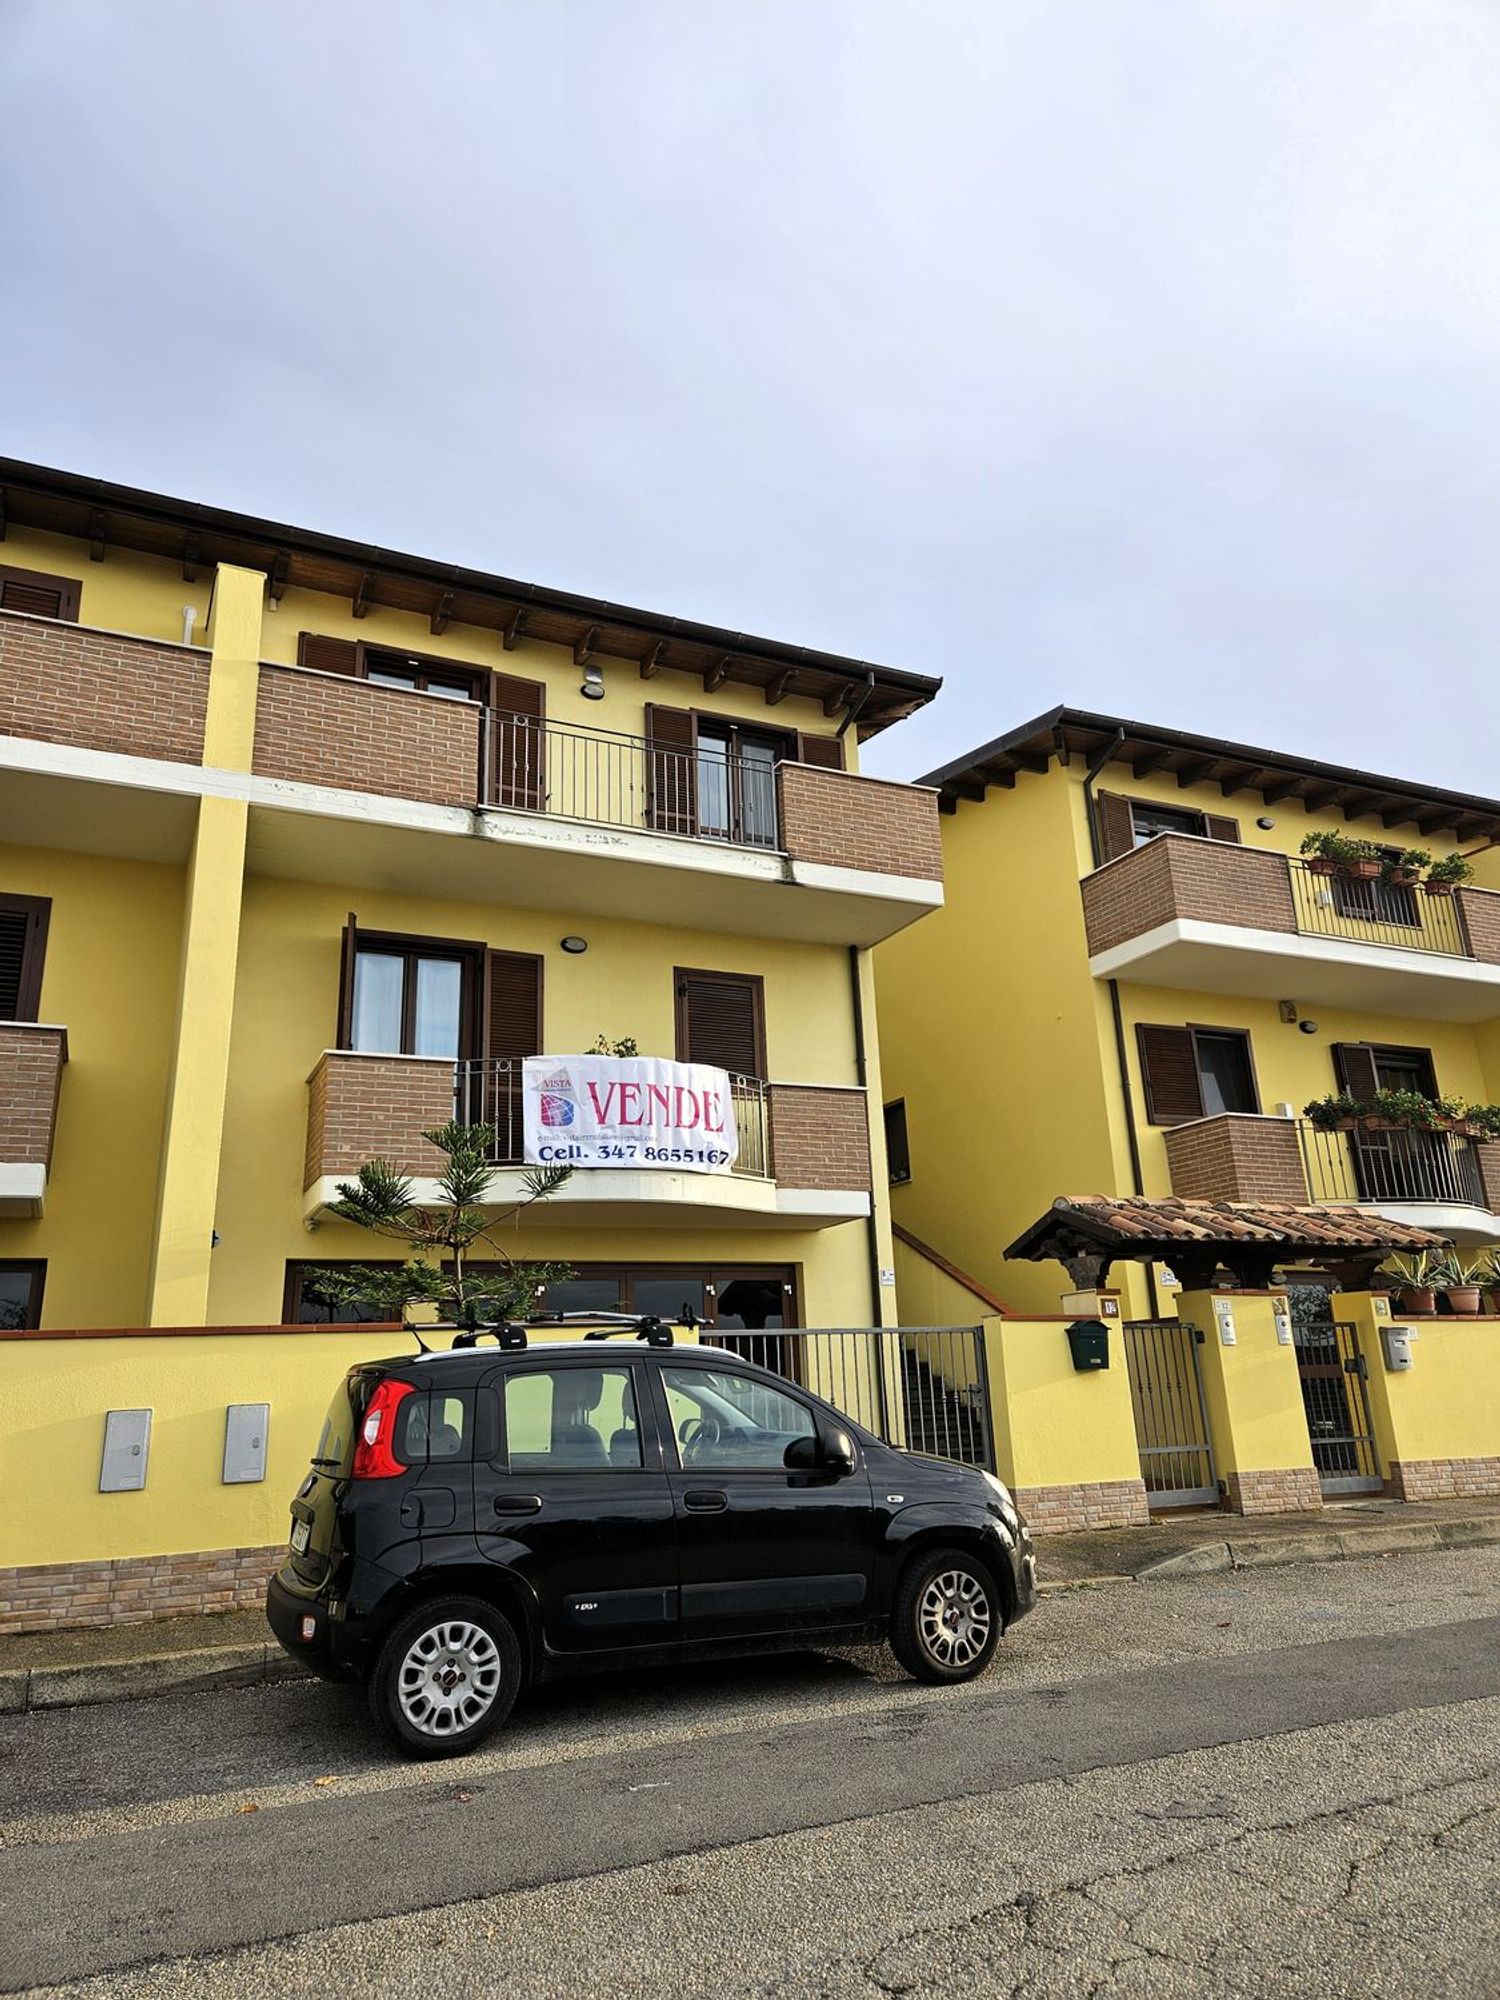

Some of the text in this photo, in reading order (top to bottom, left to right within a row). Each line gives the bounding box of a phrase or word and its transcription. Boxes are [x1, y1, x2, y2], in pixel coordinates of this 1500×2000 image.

[543, 1079, 572, 1088] VISTA
[586, 1081, 724, 1133] VENDE
[538, 1144, 729, 1165] Cell. 347 8655167
